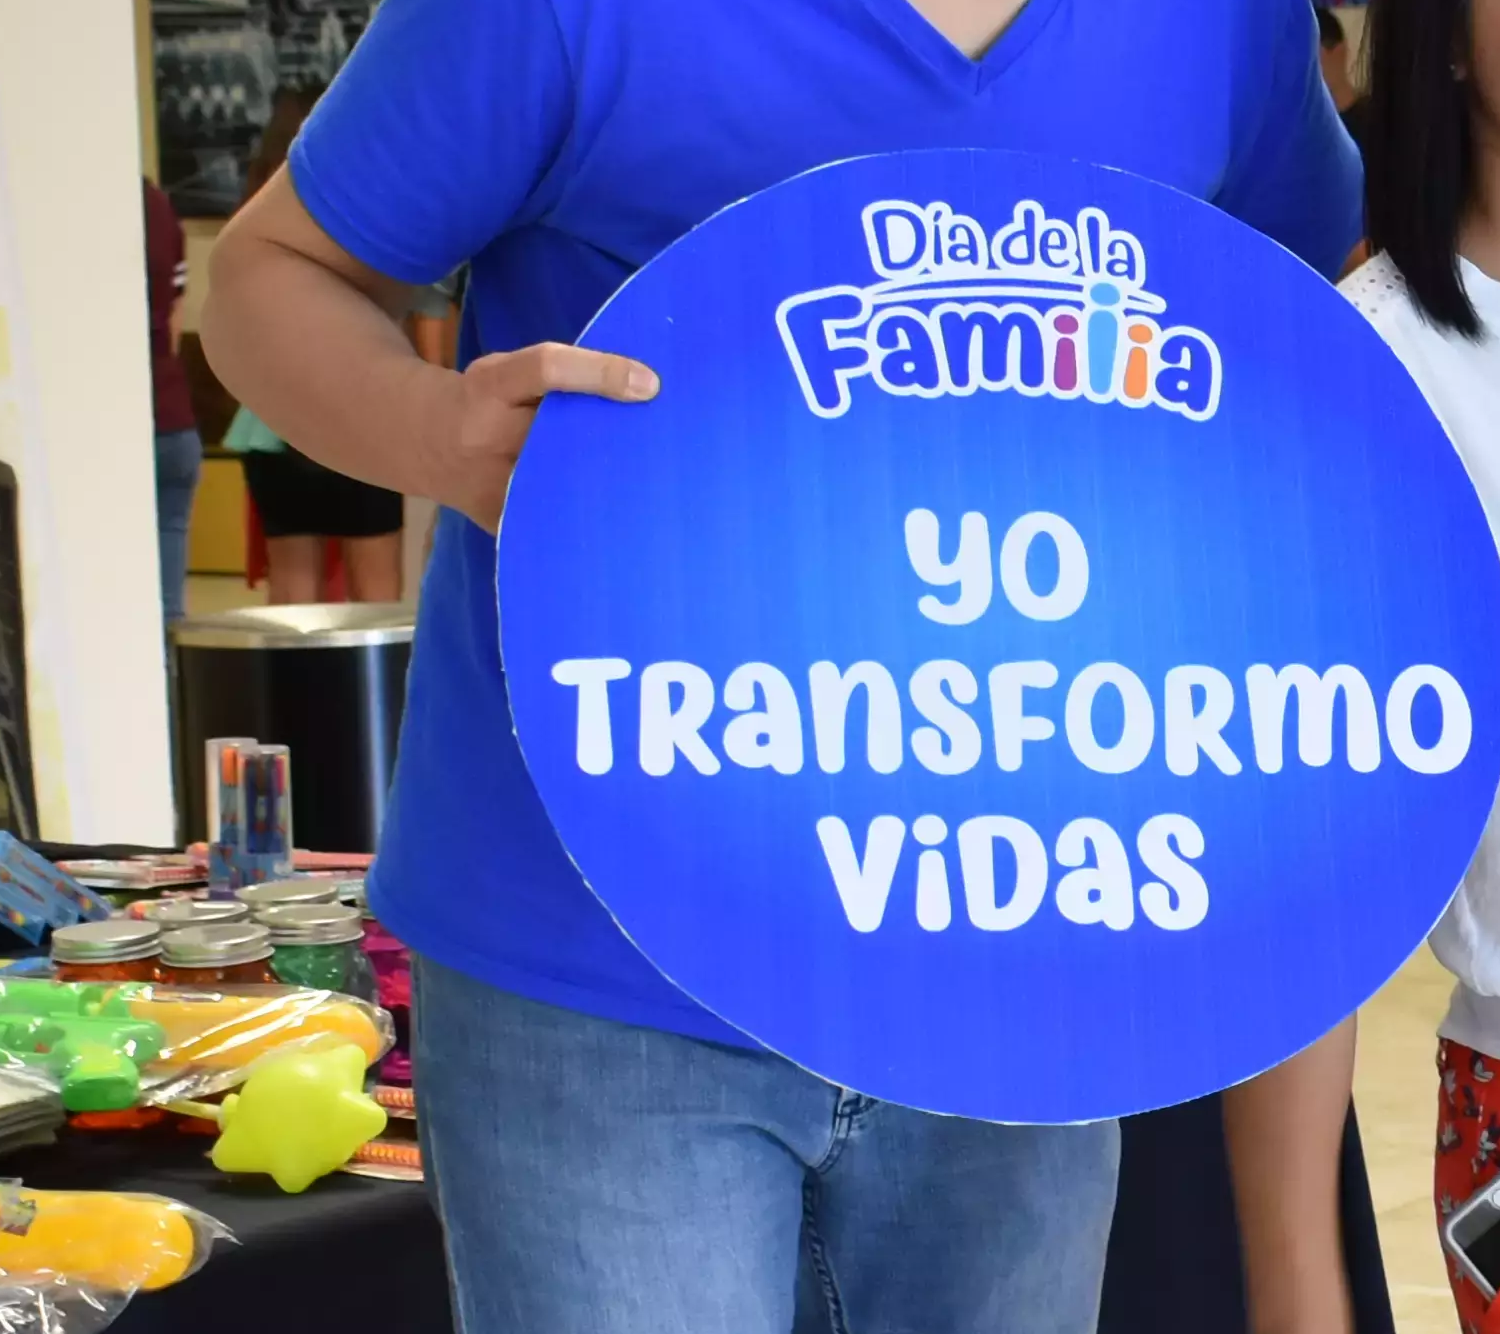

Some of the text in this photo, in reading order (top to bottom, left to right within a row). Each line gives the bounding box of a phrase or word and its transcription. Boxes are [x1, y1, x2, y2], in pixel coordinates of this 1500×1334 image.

[868, 202, 1140, 286] Día de la
[782, 282, 1218, 420] Familia
